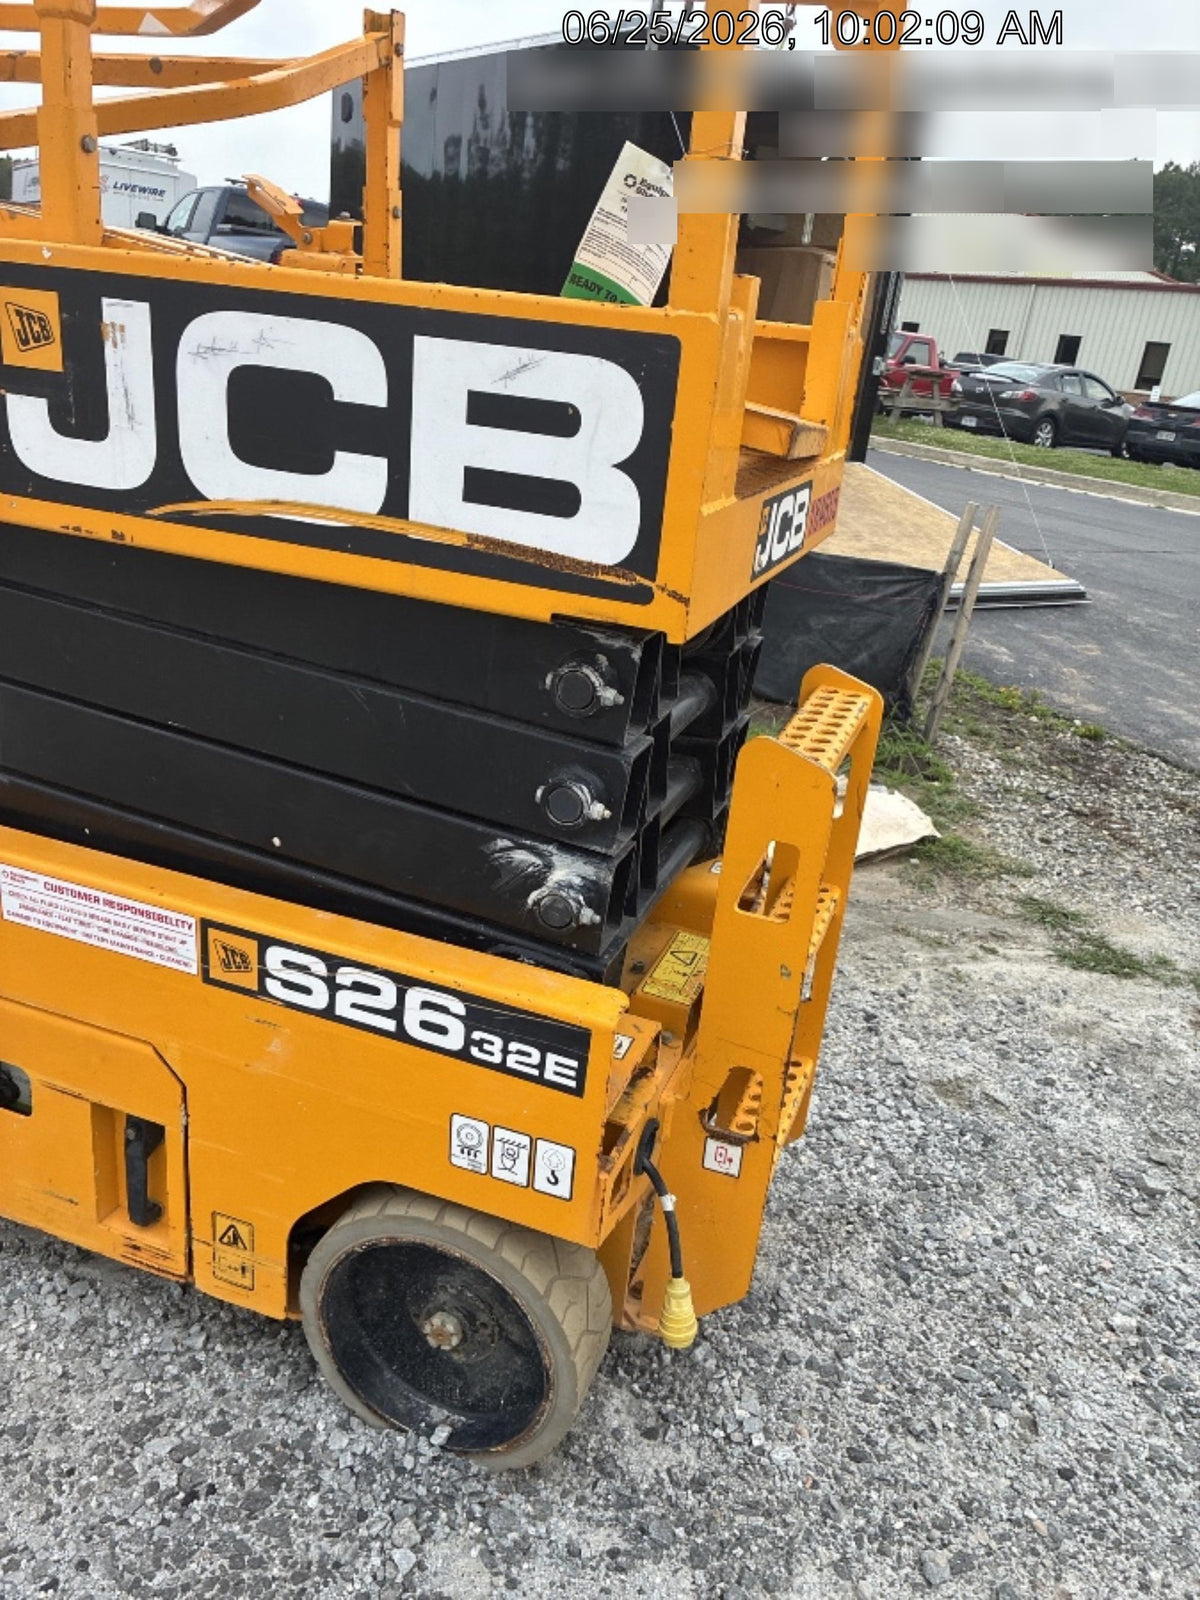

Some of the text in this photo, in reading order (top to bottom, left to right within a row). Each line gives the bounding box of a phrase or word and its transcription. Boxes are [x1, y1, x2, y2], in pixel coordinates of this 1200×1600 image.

[112, 181, 167, 197] LIVEWIRE
[568, 273, 618, 303] READY TO
[14, 308, 51, 347] JCB
[5, 297, 645, 566] JCB
[753, 487, 810, 575] JCB
[43, 881, 192, 930] CUSTOMER RESPONSIBILITY
[220, 943, 250, 970] JCB
[264, 944, 578, 1089] S26 32E
